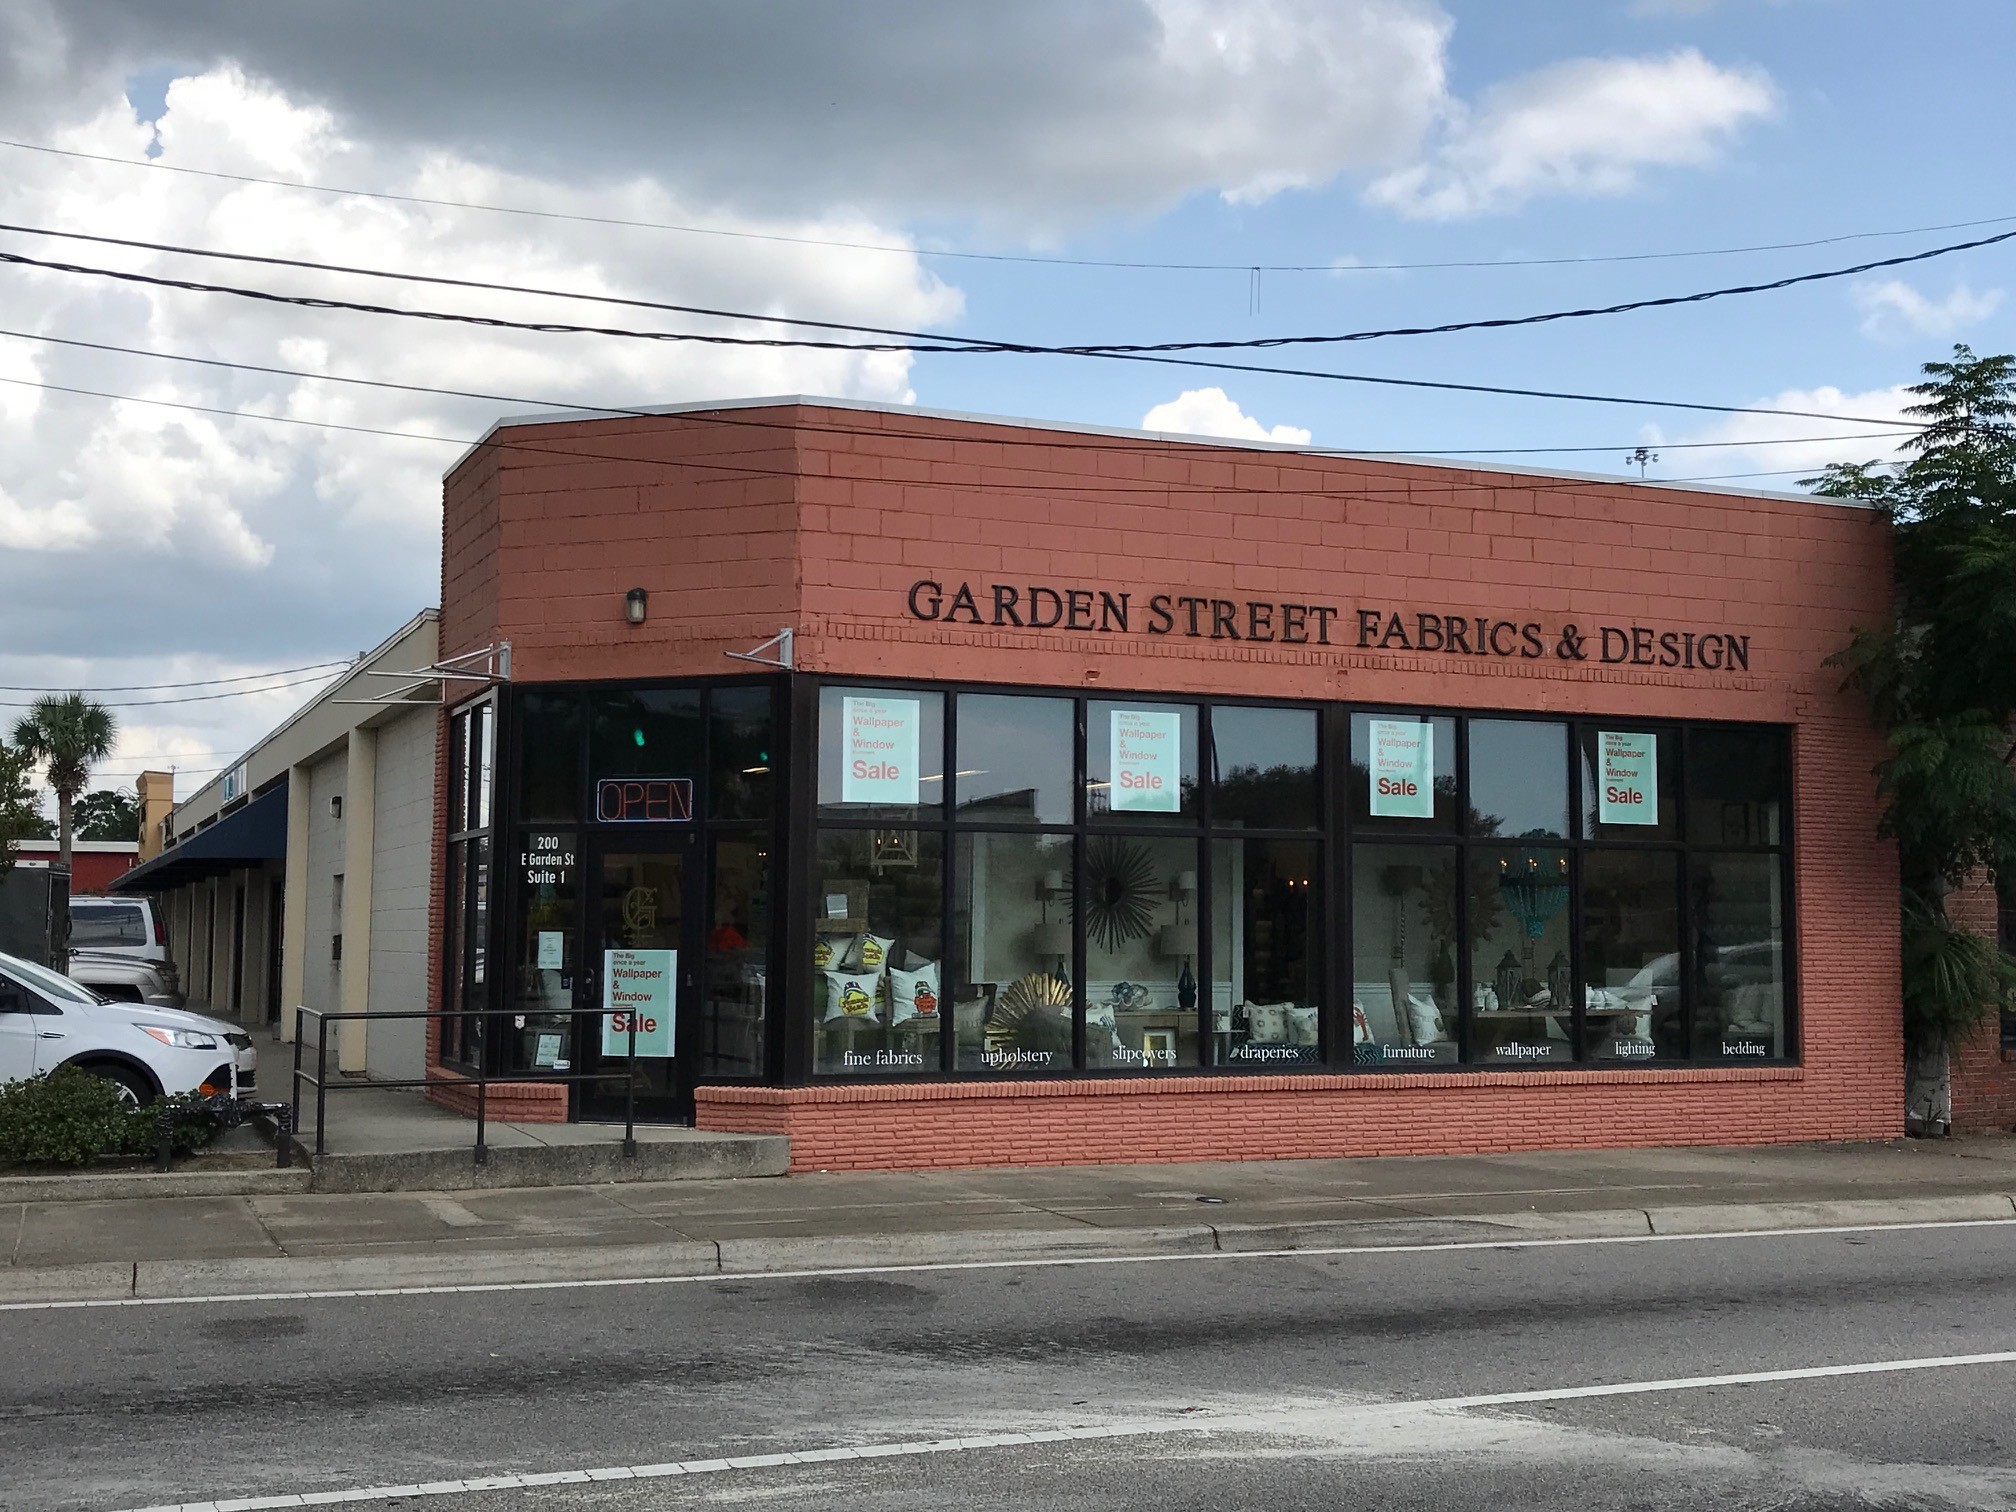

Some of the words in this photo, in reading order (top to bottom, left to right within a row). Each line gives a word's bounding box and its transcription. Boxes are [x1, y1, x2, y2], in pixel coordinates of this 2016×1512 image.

[907, 579, 1131, 633] GARDEN
[1148, 593, 1338, 645] STREET
[1356, 608, 1544, 659] FABRICS
[1556, 623, 1589, 661] &
[1599, 625, 1751, 671] DESIGN
[852, 716, 904, 728] Wallpaper
[853, 727, 860, 737] &
[1119, 728, 1166, 740] Wallpaper
[852, 739, 895, 750] Window
[1119, 739, 1126, 749] &
[1377, 738, 1421, 749] Wallpaper
[1119, 750, 1158, 760] Window
[1605, 748, 1646, 759] Wallpaper
[852, 759, 900, 780] Sale
[1377, 758, 1413, 768] Window
[1119, 770, 1163, 789] Sale
[1605, 768, 1638, 777] Window
[1377, 777, 1418, 796] Sale
[600, 781, 691, 820] OPEN
[1606, 786, 1643, 804] Sale
[537, 836, 559, 850] 200
[521, 854, 527, 866] E
[529, 853, 563, 866] Garden
[564, 853, 575, 866] St
[527, 870, 557, 884] Suite
[560, 870, 566, 884] 1
[613, 968, 662, 980] Wallpaper
[613, 980, 620, 989] &
[612, 991, 652, 1001] Window
[612, 1011, 657, 1033] Sale
[1112, 1045, 1177, 1063] slipcovers
[1240, 1044, 1299, 1062] draperies
[1382, 1044, 1436, 1059] furniture
[1495, 1042, 1552, 1058] wallpaper
[1614, 1041, 1656, 1057] lighting
[1722, 1041, 1765, 1057] bedding
[843, 1050, 871, 1066] fine
[875, 1049, 923, 1065] fabrics
[980, 1047, 1053, 1066] upholstery
